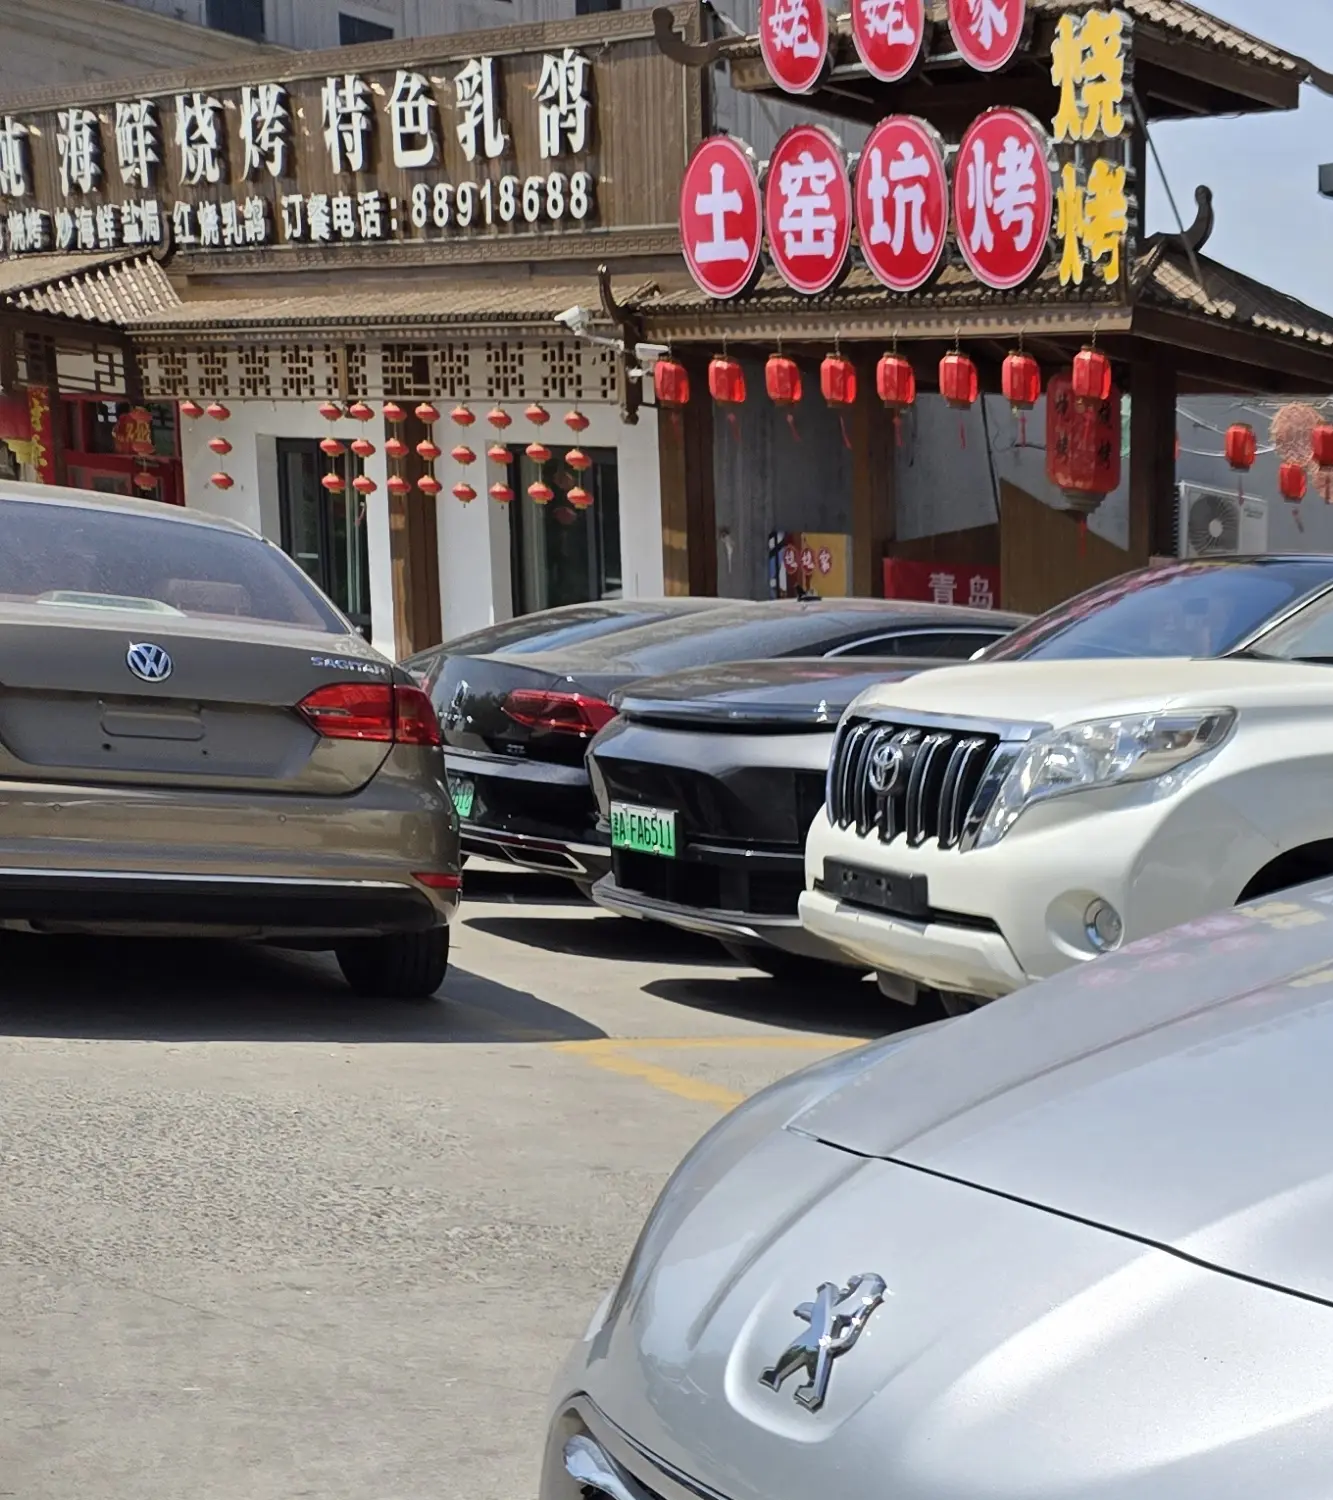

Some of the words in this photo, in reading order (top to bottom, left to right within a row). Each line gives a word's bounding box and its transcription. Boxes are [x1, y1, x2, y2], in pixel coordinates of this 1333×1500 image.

[56, 84, 288, 197] 海鲜烧烤
[320, 48, 592, 175] 特色乳鸽
[1050, 8, 1129, 285] 烧烤
[694, 136, 1037, 265] 土窑坑烤
[928, 572, 994, 611] 青岛
